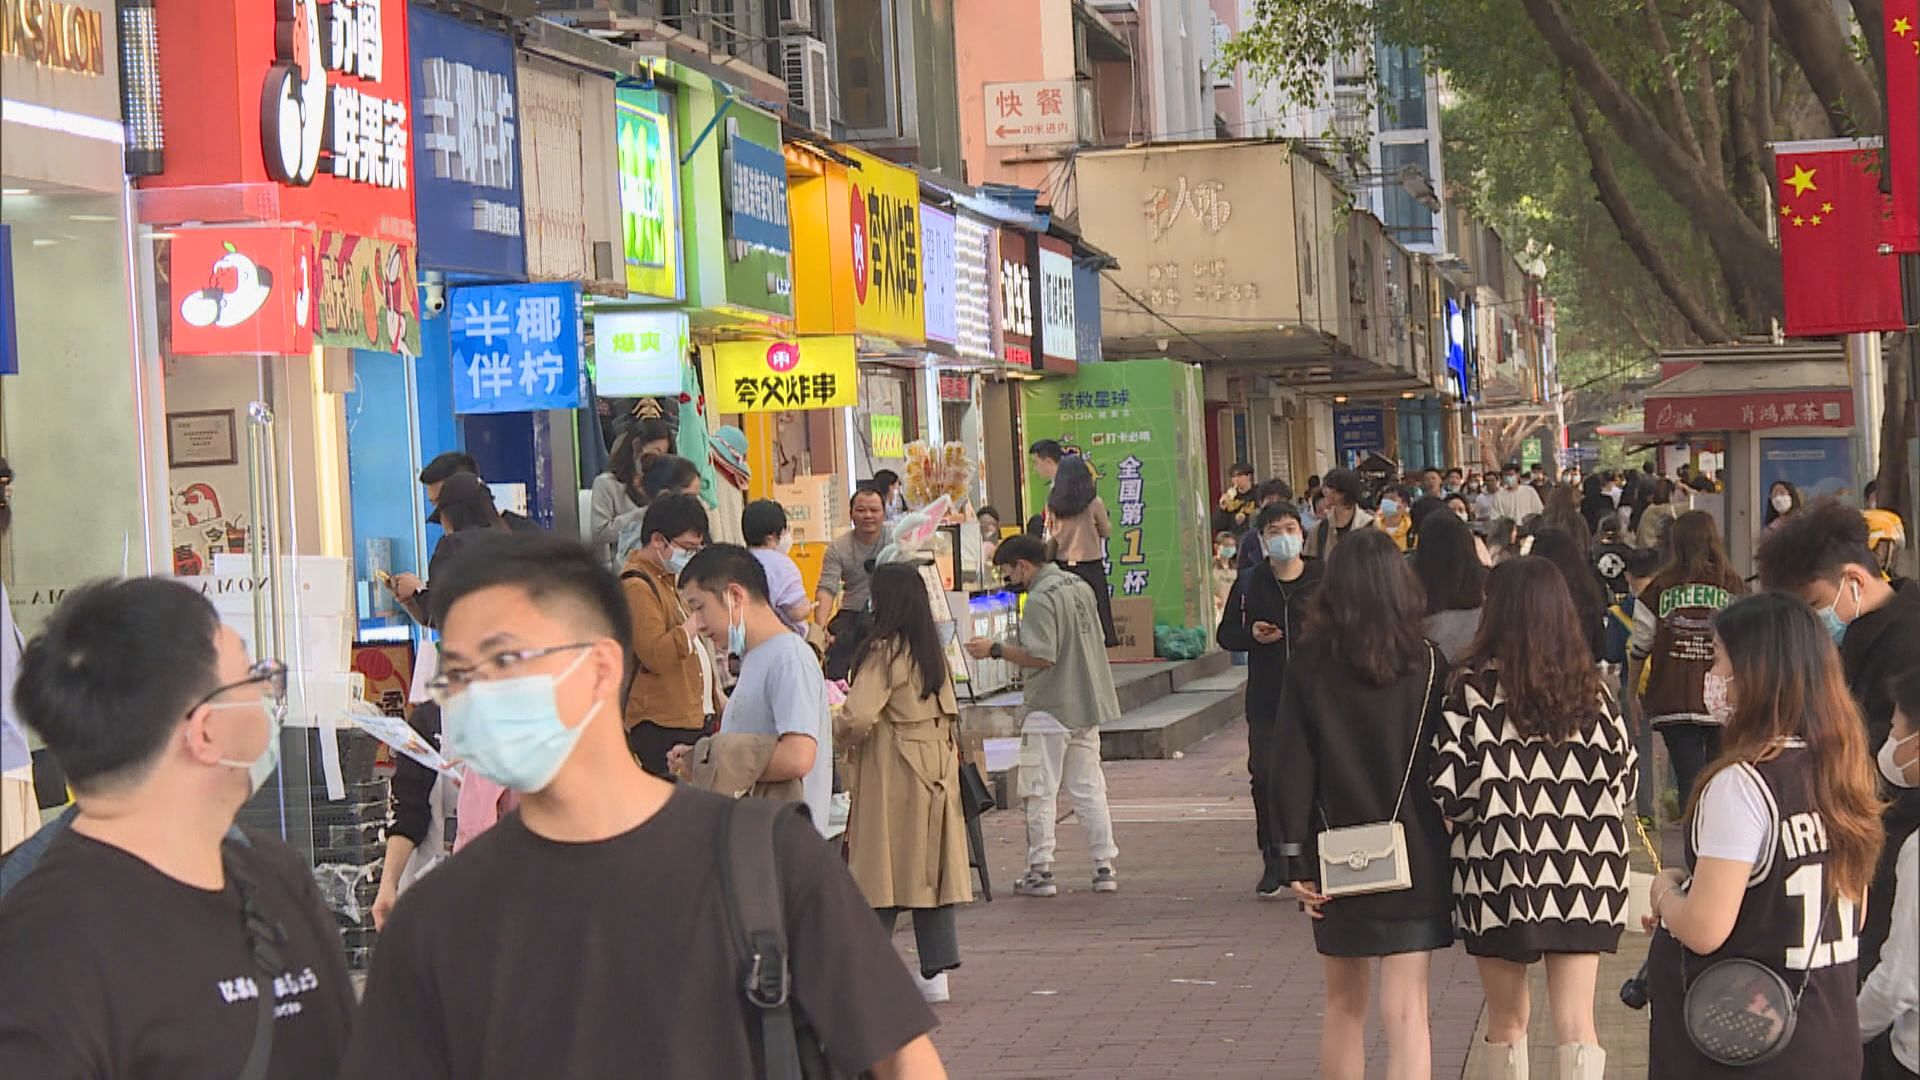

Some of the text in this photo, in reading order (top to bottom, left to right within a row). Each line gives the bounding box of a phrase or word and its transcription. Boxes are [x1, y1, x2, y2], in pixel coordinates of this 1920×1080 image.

[996, 88, 1062, 118] 快餐
[333, 83, 408, 191] 鲜果茶
[867, 186, 917, 320] 夸父炸串
[465, 296, 561, 346] 半椰
[467, 350, 564, 399] 伴柠
[735, 373, 837, 409] 夸父炸串
[1058, 389, 1130, 409] 茶救星球
